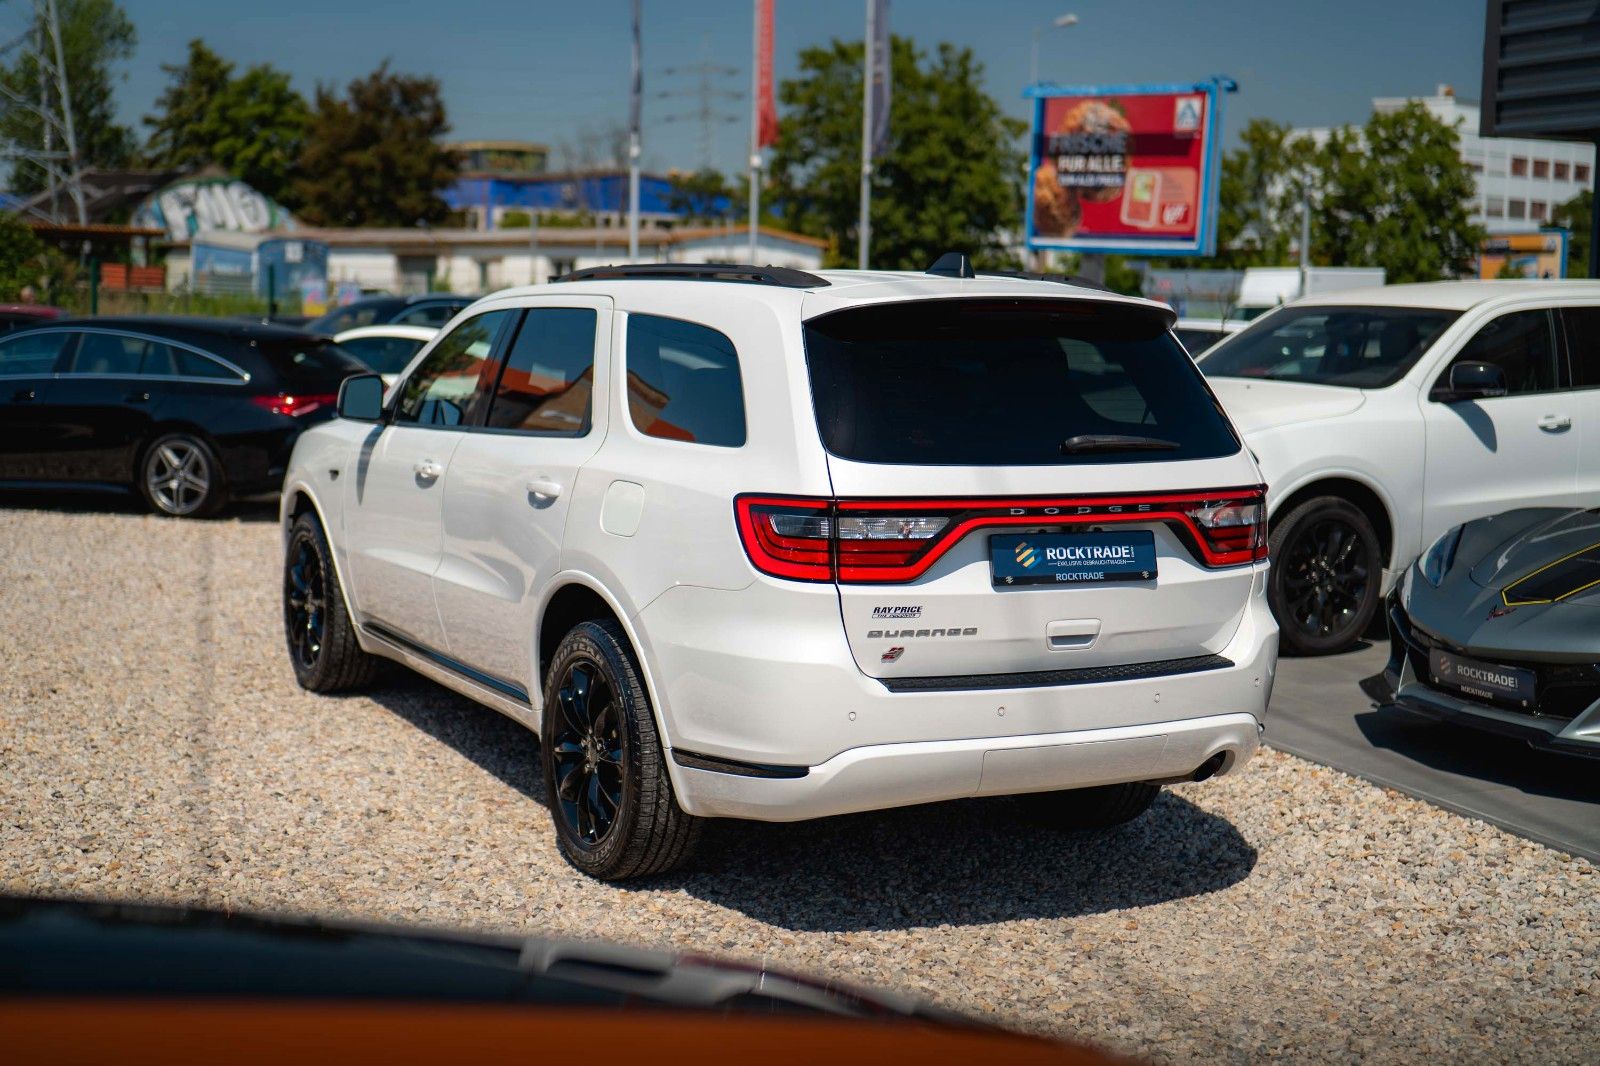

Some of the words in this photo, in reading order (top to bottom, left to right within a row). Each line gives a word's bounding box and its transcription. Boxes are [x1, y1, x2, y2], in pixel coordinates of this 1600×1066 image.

[1010, 504, 1151, 515] DODGE
[1046, 546, 1130, 560] ROCKTRADE
[1055, 572, 1104, 581] ROCKTRADE
[873, 606, 893, 614] RAY
[894, 605, 923, 613] PRICE
[867, 627, 978, 639] DURANGO
[1457, 664, 1515, 688] ROCKTRADE
